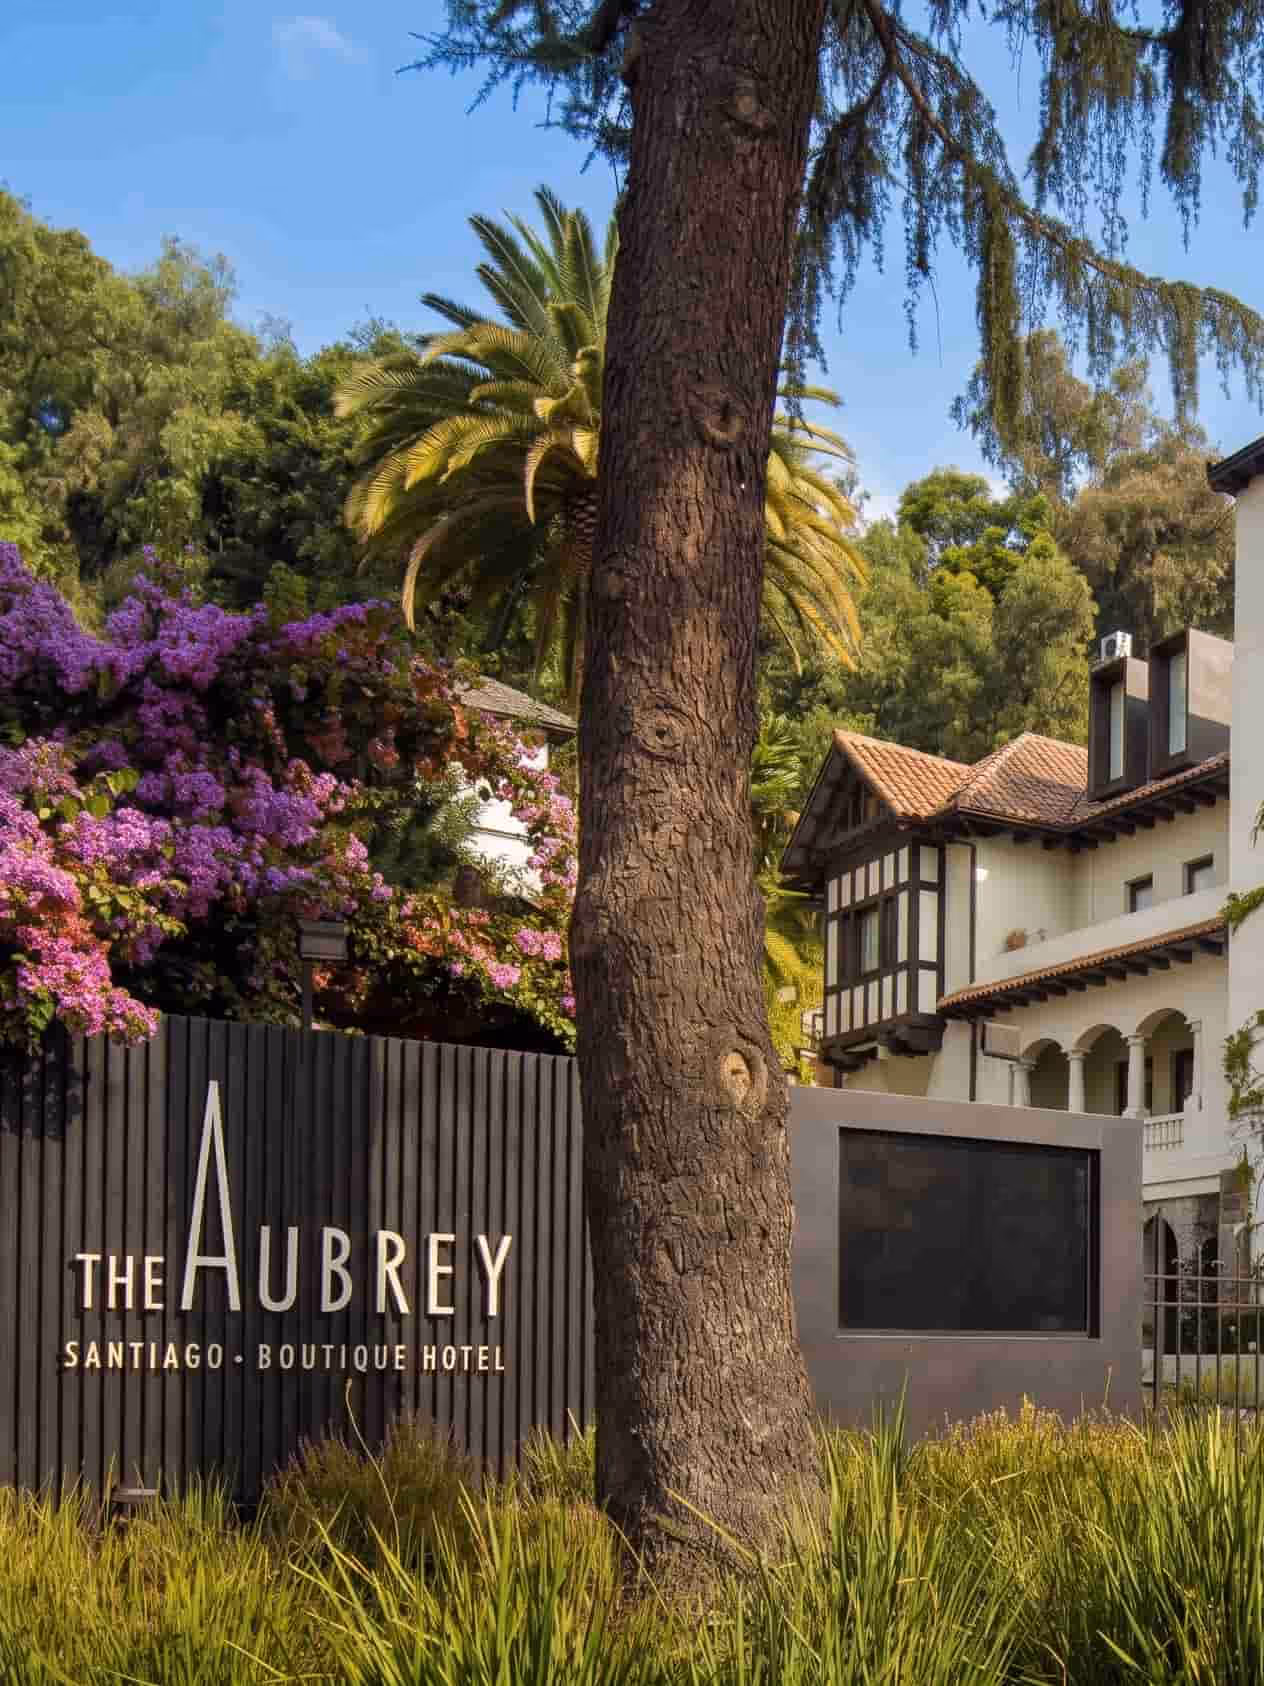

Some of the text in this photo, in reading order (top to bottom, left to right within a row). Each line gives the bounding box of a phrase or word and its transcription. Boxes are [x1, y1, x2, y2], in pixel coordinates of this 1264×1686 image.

[75, 1080, 513, 1316] THE AUBREY
[64, 1341, 506, 1372] SANTIAGO BOUTIQUE HOTEL
